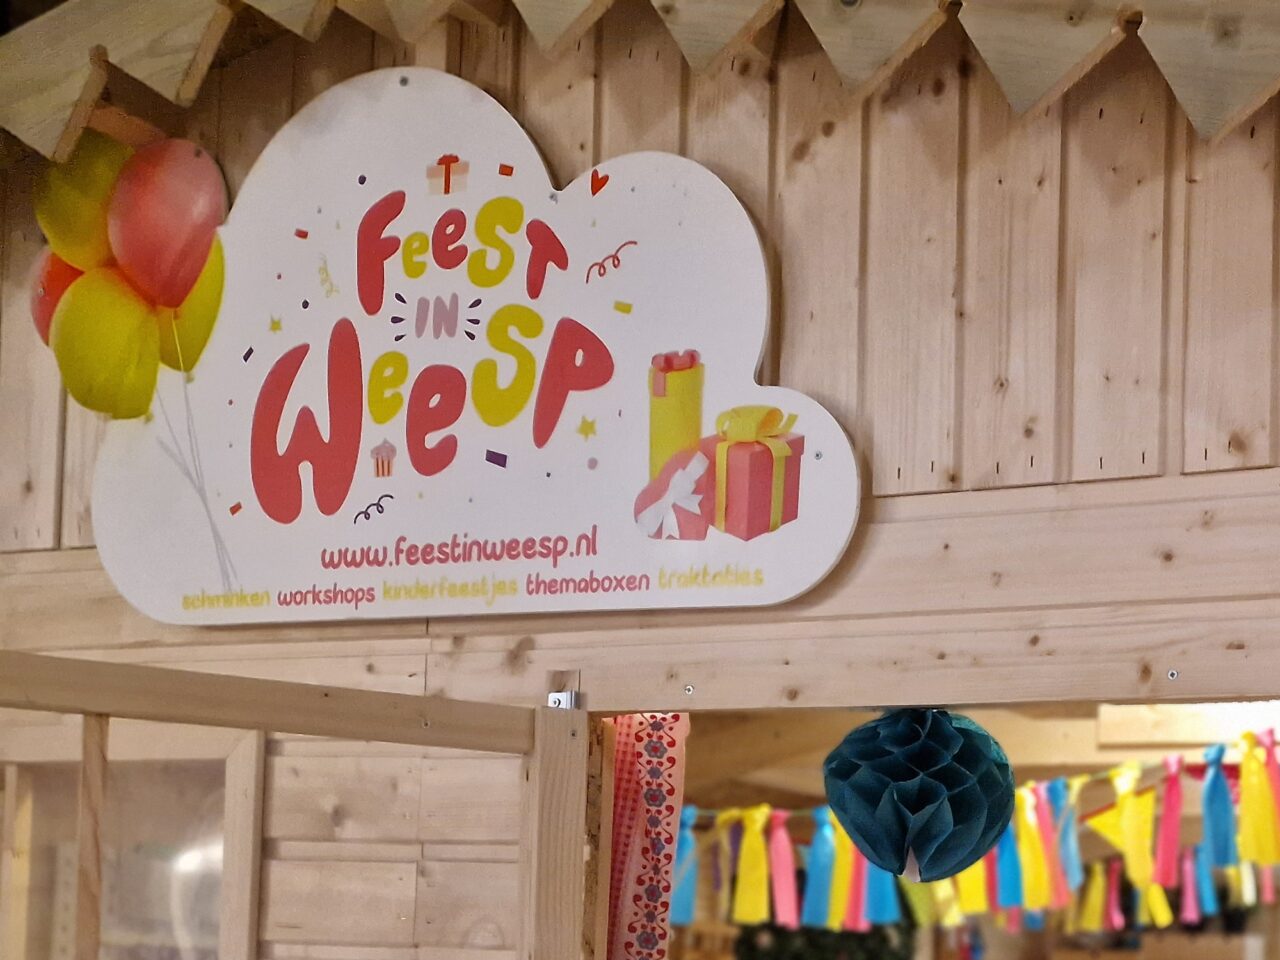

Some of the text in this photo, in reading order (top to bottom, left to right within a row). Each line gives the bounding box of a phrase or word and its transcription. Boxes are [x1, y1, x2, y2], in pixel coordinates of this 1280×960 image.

[415, 292, 459, 339] IN
[321, 524, 598, 569] www.feestinweesp.nl
[277, 582, 376, 610] workshops
[382, 573, 518, 607] kinderfeestjes
[526, 569, 650, 595] themaboxen
[658, 562, 764, 590] traktaties
